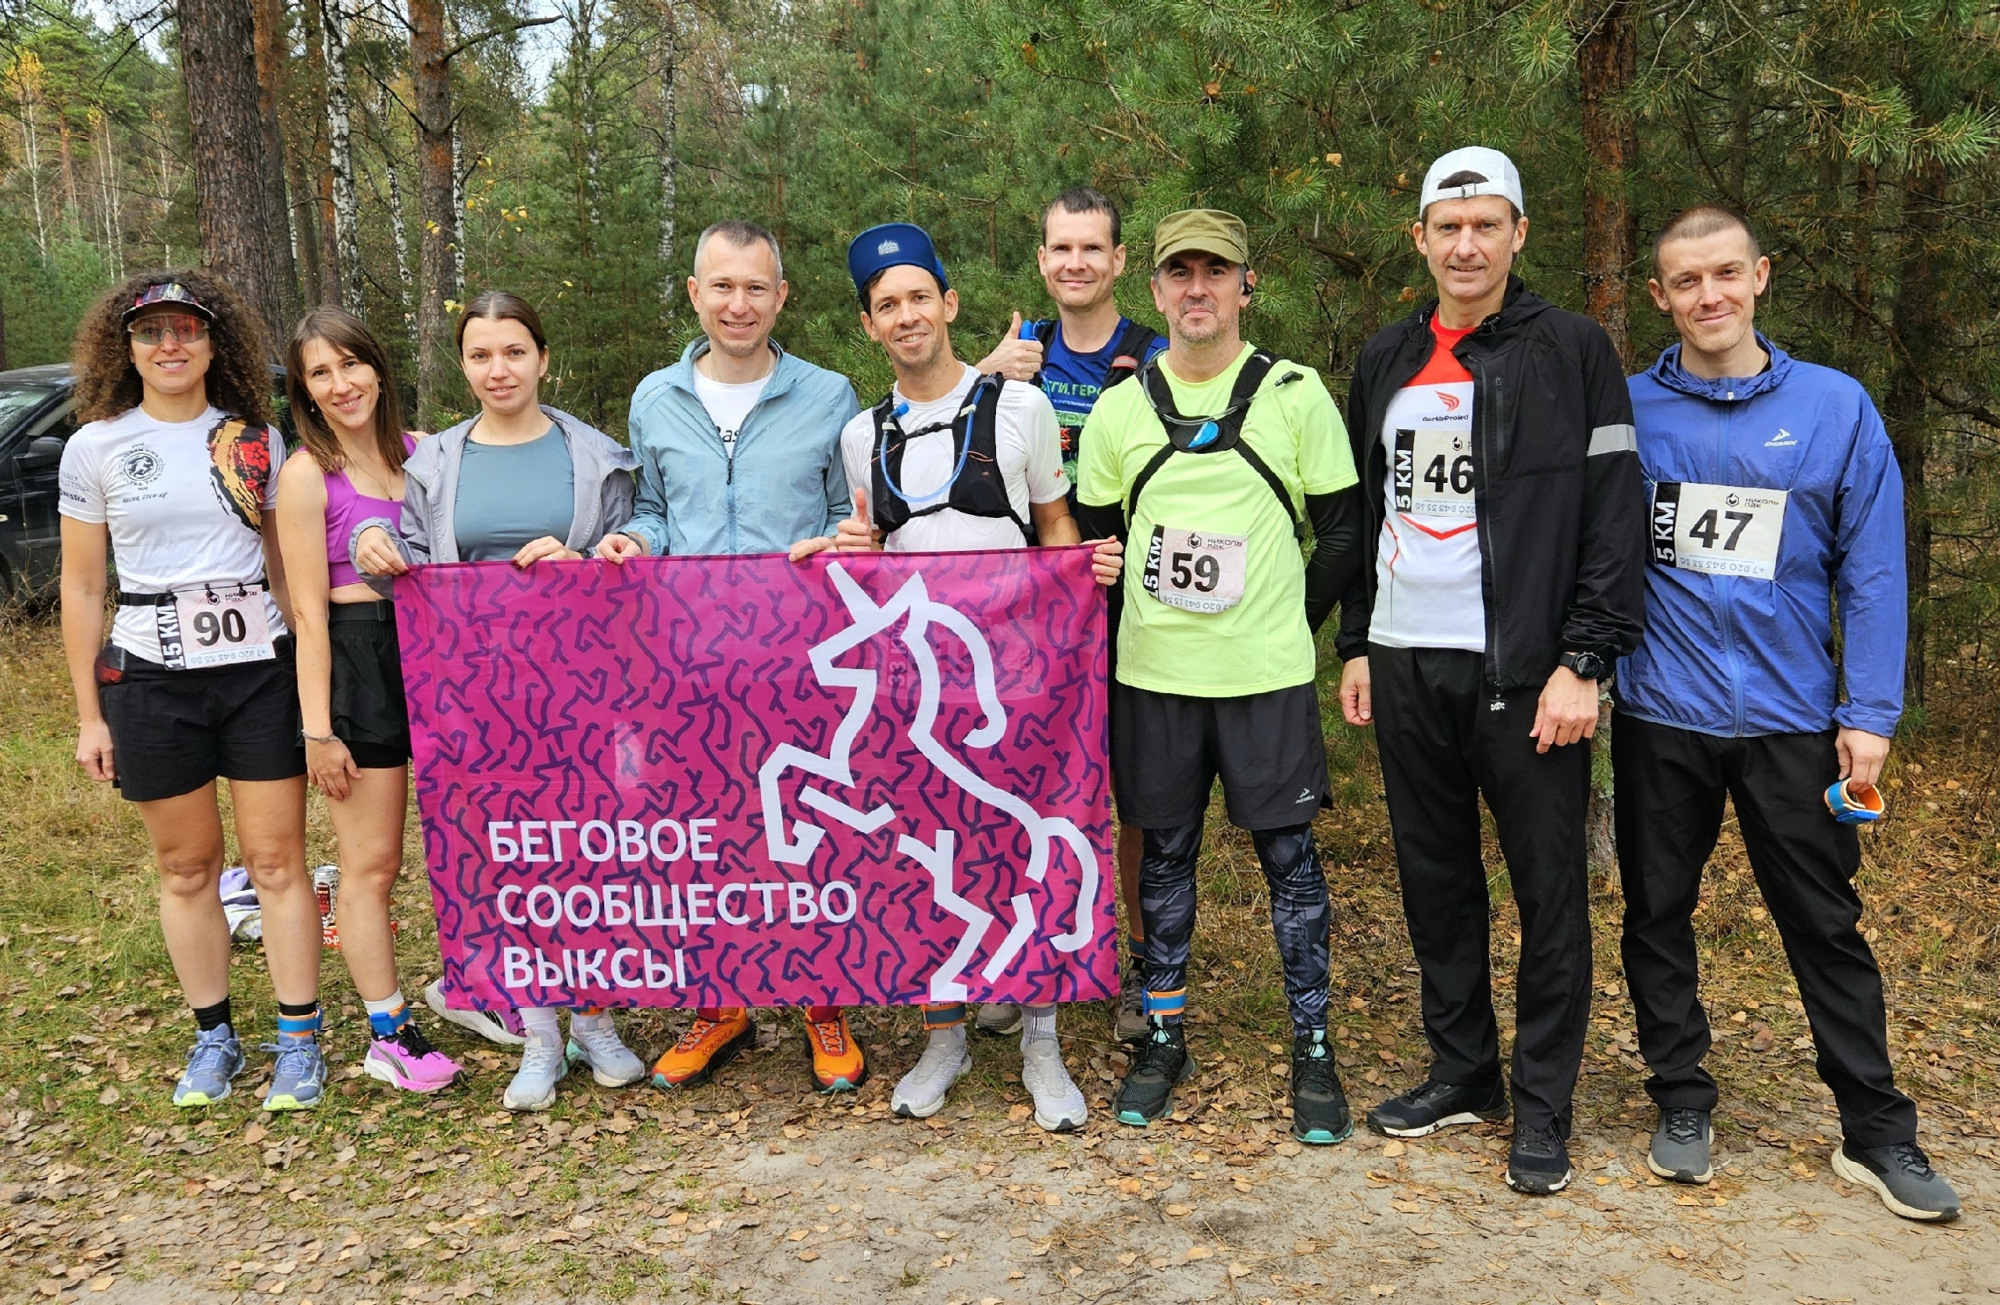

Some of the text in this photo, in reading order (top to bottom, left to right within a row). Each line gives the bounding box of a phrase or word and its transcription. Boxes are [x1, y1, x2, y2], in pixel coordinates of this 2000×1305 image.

[1424, 454, 1475, 494] 46
[1396, 494, 1411, 510] 5
[1689, 509, 1753, 551] 47
[1170, 551, 1220, 592] 59
[1656, 547, 1675, 562] 5
[193, 608, 246, 646] 90
[162, 642, 185, 669] 15
[488, 818, 718, 862] БЕГОВОЕ
[497, 881, 857, 936] СООБЩЕСТВО
[504, 946, 687, 990] ВЫКСЫ
